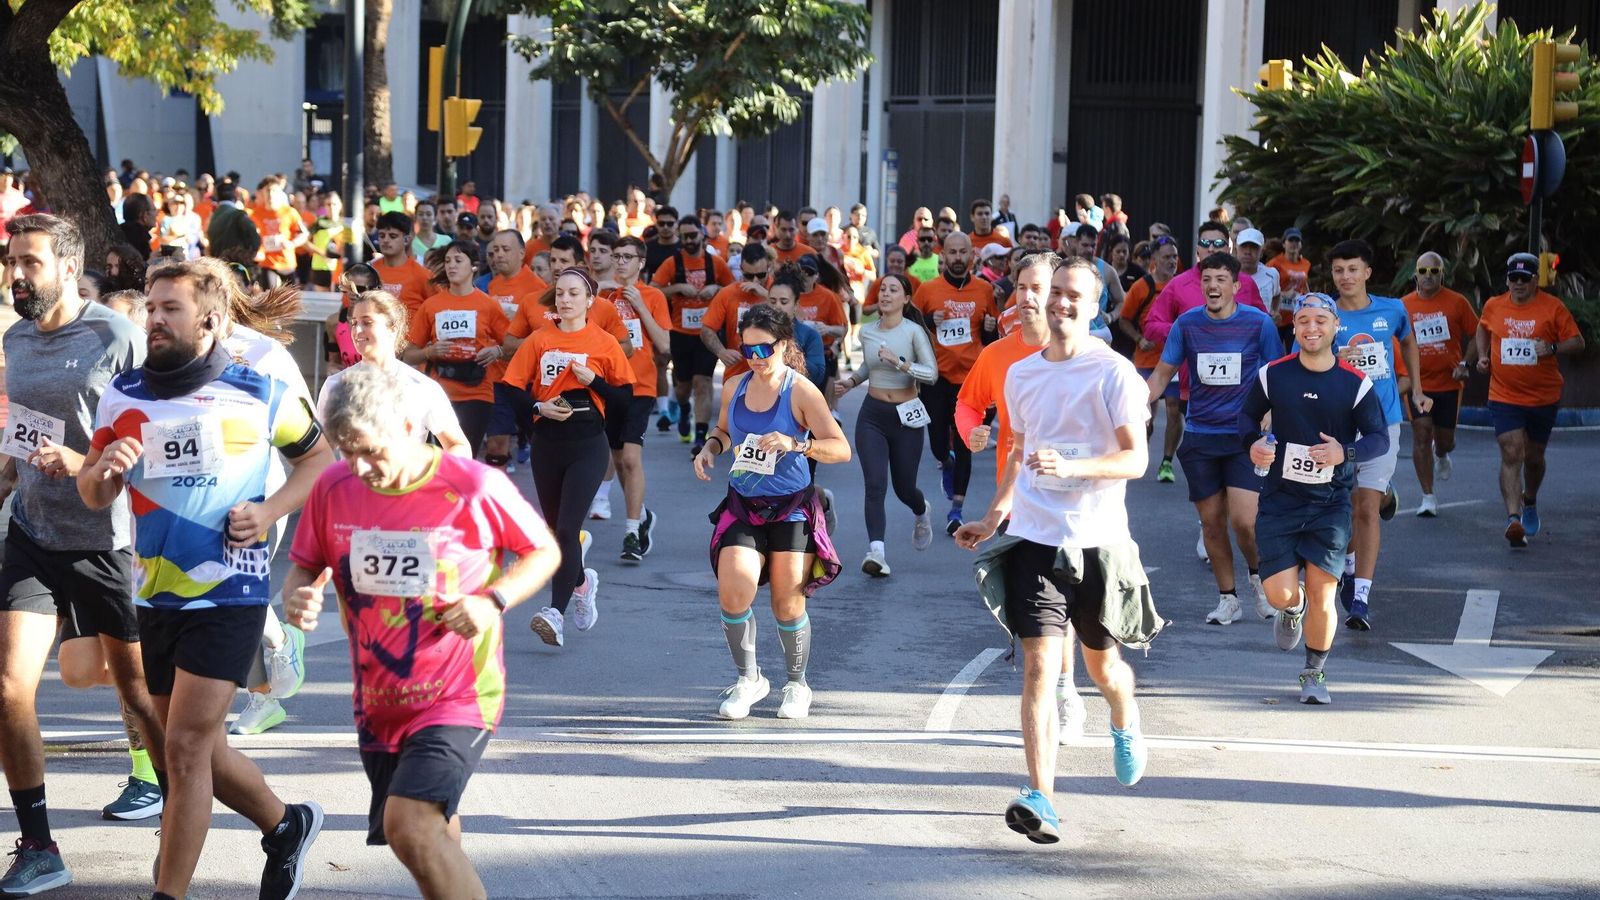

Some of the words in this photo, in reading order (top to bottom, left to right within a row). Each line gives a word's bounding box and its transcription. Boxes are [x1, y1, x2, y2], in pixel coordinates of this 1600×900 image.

[441, 320, 469, 330] 404
[1420, 325, 1443, 337] 119
[941, 327, 965, 338] 719
[1506, 347, 1531, 357] 176
[546, 364, 566, 376] 26
[1208, 364, 1227, 376] 71
[164, 438, 199, 460] 94
[171, 475, 218, 488] 2024
[363, 554, 420, 577] 372
[385, 692, 434, 706] LIMITE
